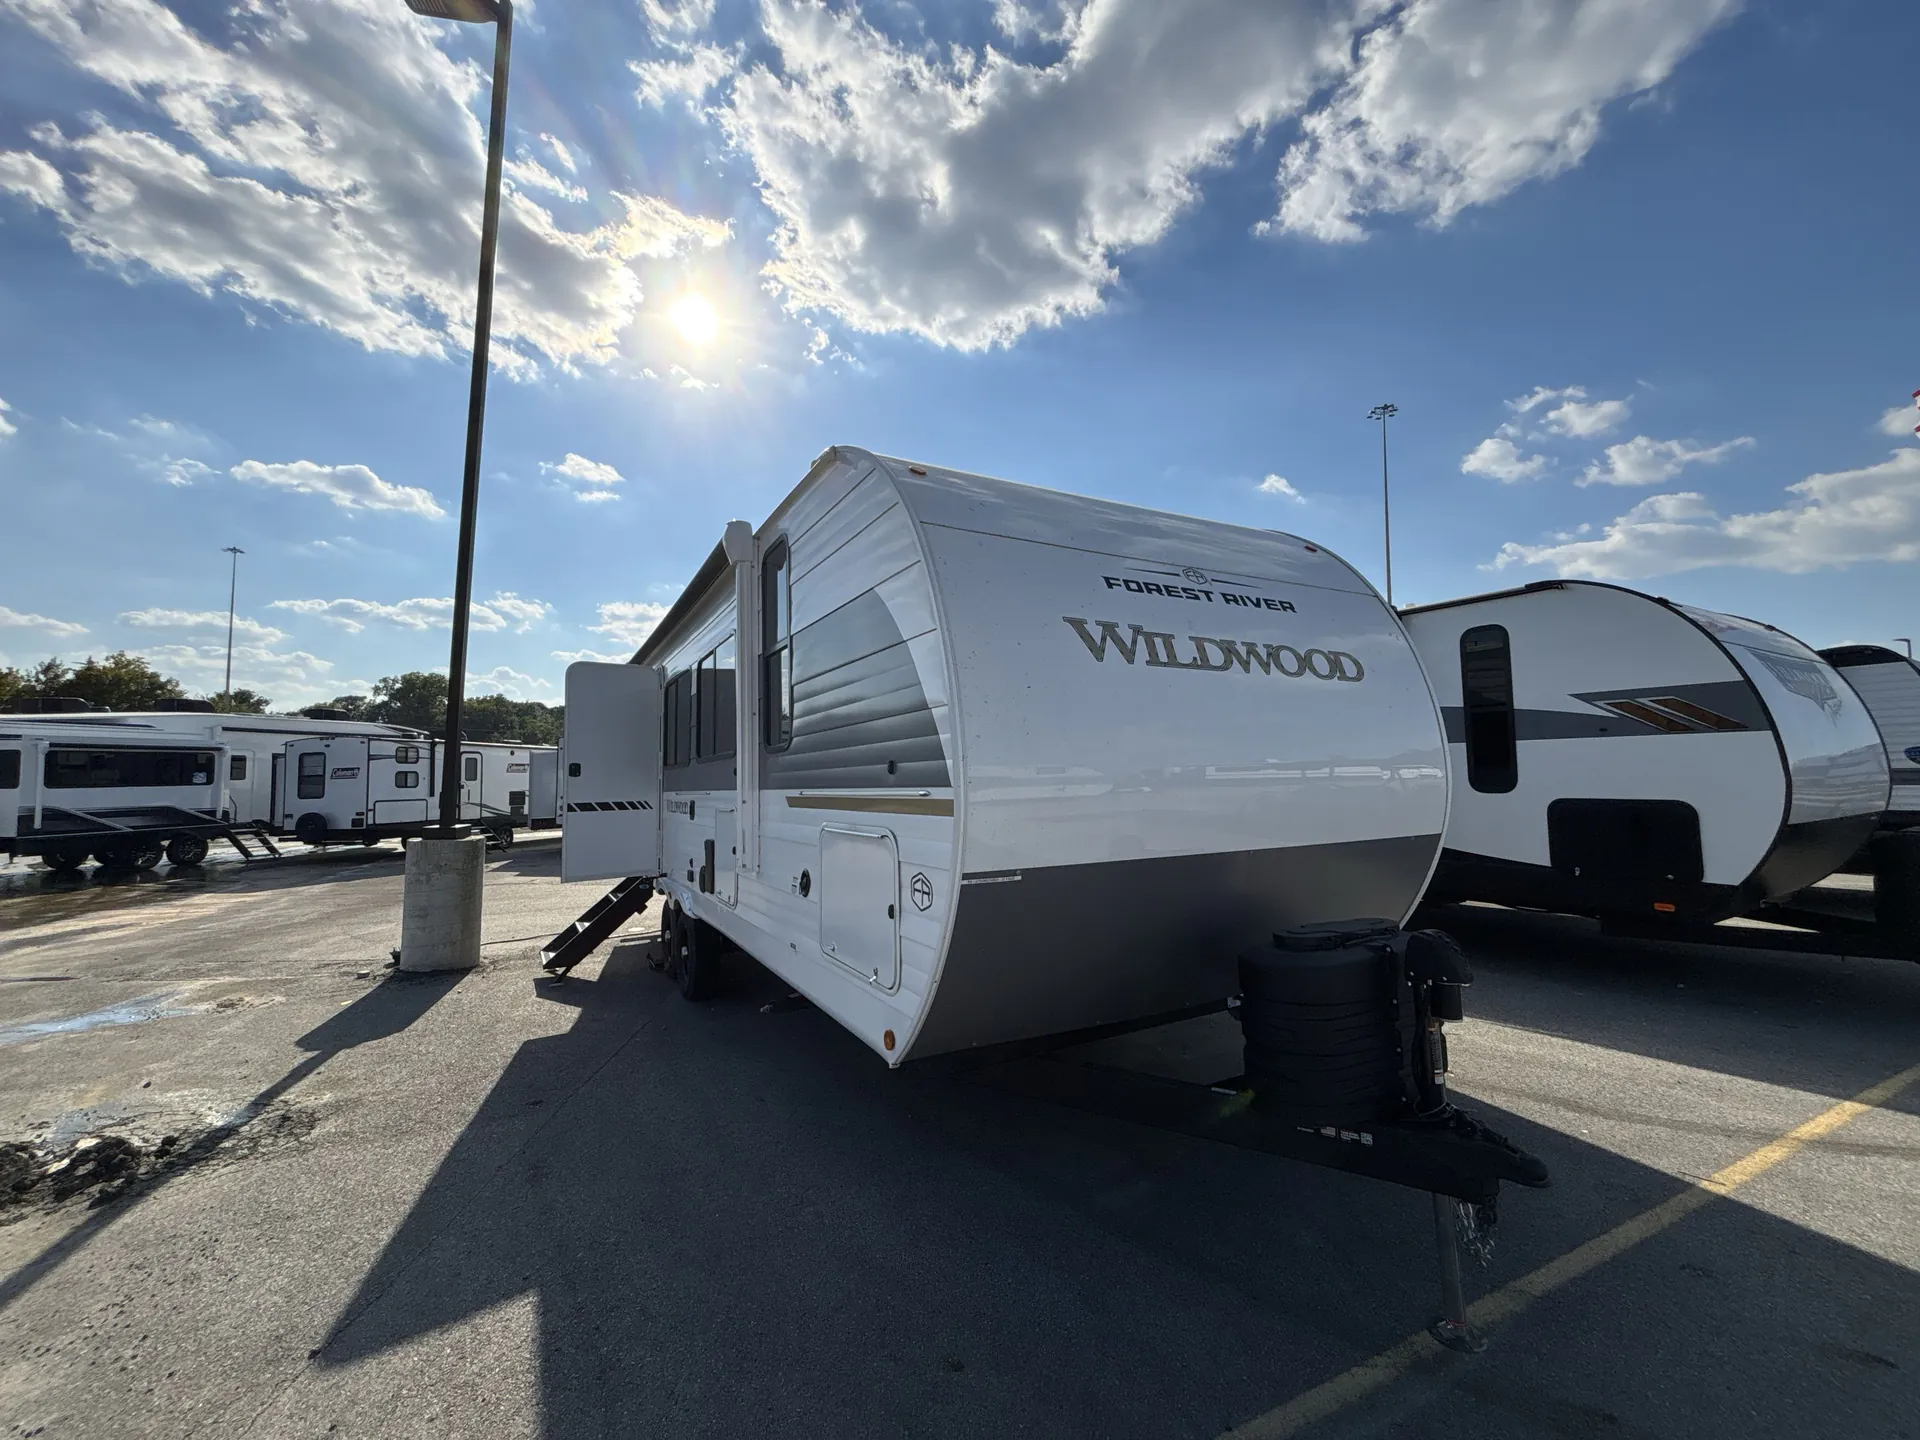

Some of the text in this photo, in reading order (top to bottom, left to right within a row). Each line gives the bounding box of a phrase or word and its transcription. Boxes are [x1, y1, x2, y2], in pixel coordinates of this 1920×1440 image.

[1101, 575, 1298, 613] FOREST RIVER
[1062, 616, 1365, 682] WILDWOOD
